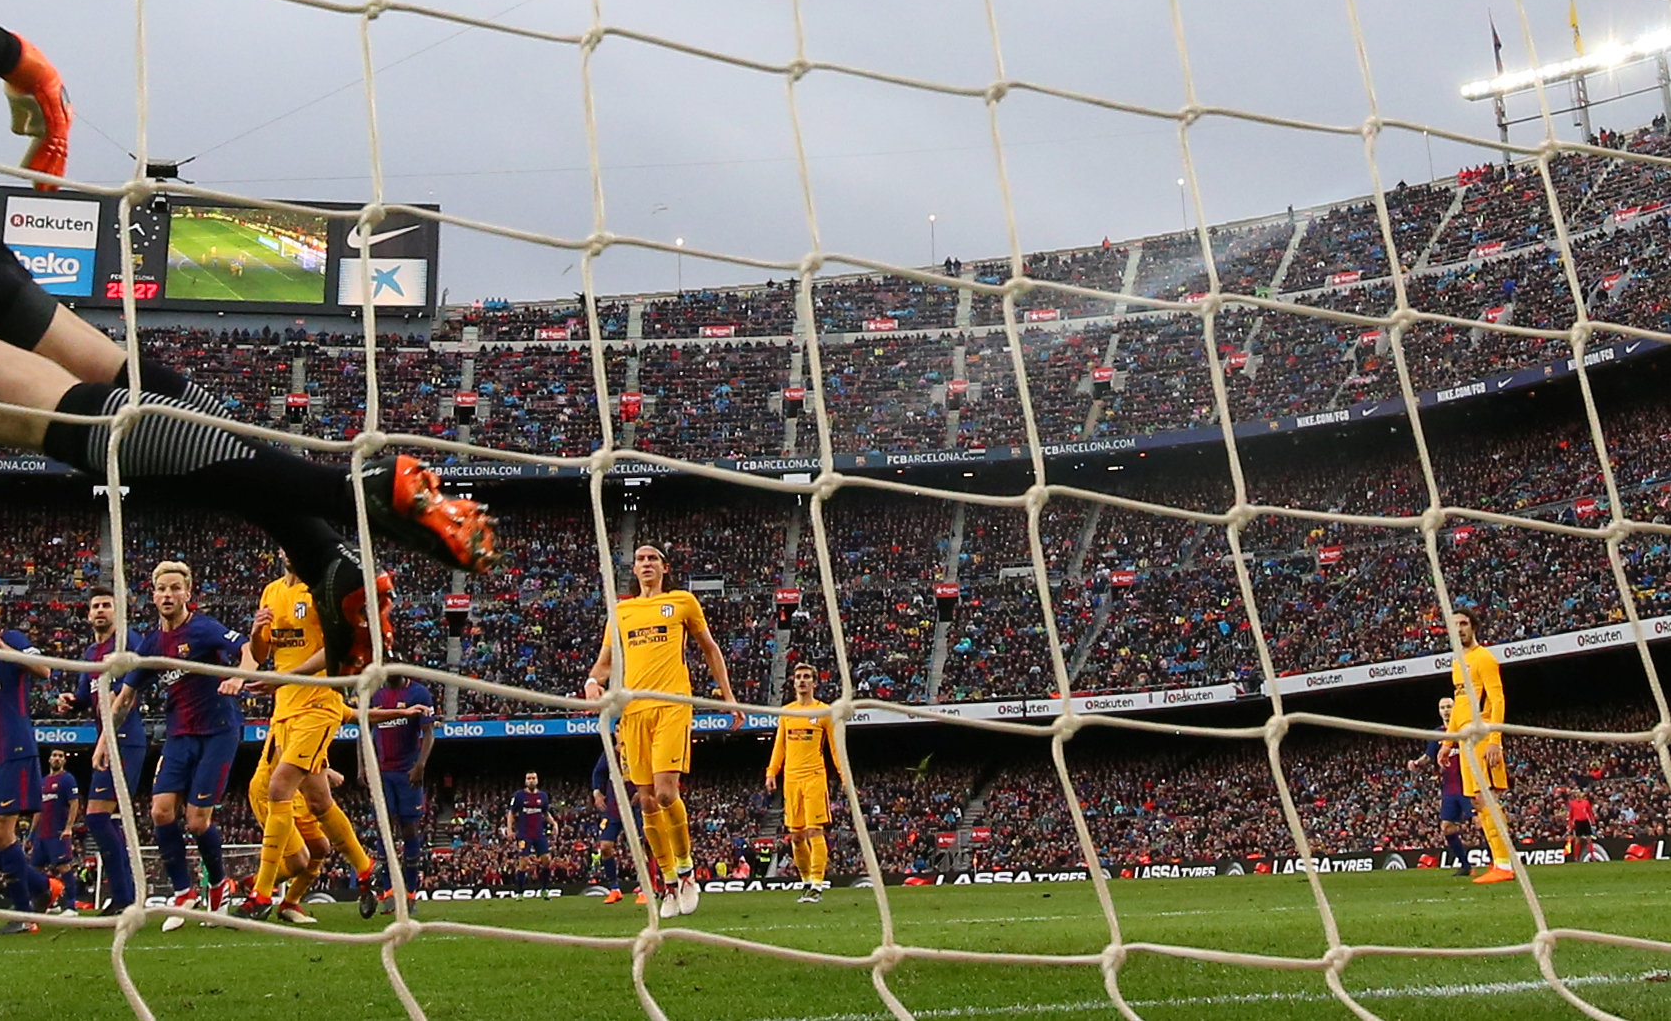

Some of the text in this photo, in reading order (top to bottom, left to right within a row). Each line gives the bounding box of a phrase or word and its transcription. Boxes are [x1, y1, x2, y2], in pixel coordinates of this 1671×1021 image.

[24, 215, 94, 232] Rakuten
[1313, 629, 1623, 686] Rakuten Rakuten Rakuten Rakuten
[1092, 698, 1134, 709] Rakuten
[35, 729, 77, 742] beko
[444, 723, 484, 736] beko
[505, 722, 545, 735] beko
[1134, 864, 1217, 879] LASSA TYRES
[1331, 858, 1373, 873] TYRES
